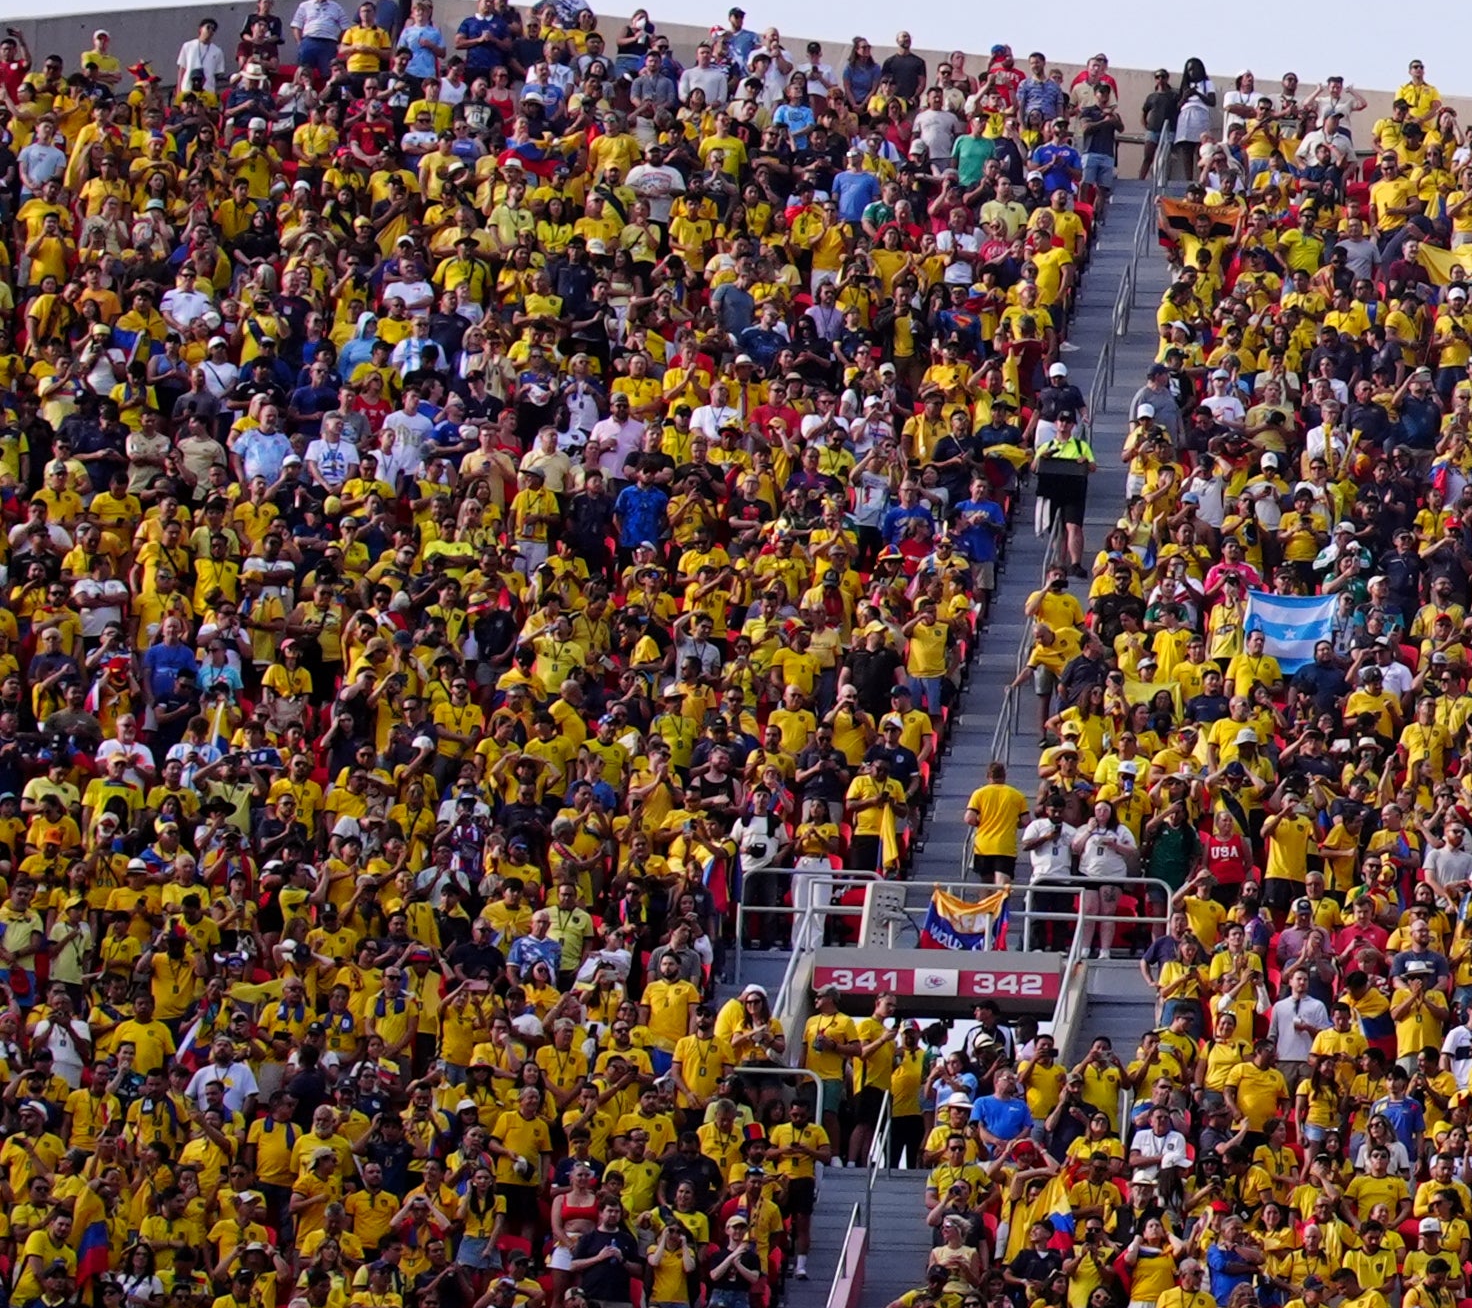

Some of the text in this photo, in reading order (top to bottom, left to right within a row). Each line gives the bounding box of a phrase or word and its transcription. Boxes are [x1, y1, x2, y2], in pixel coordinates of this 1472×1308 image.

[1210, 846, 1239, 859] USA
[831, 969, 898, 992] 341
[973, 973, 1043, 995] 342
